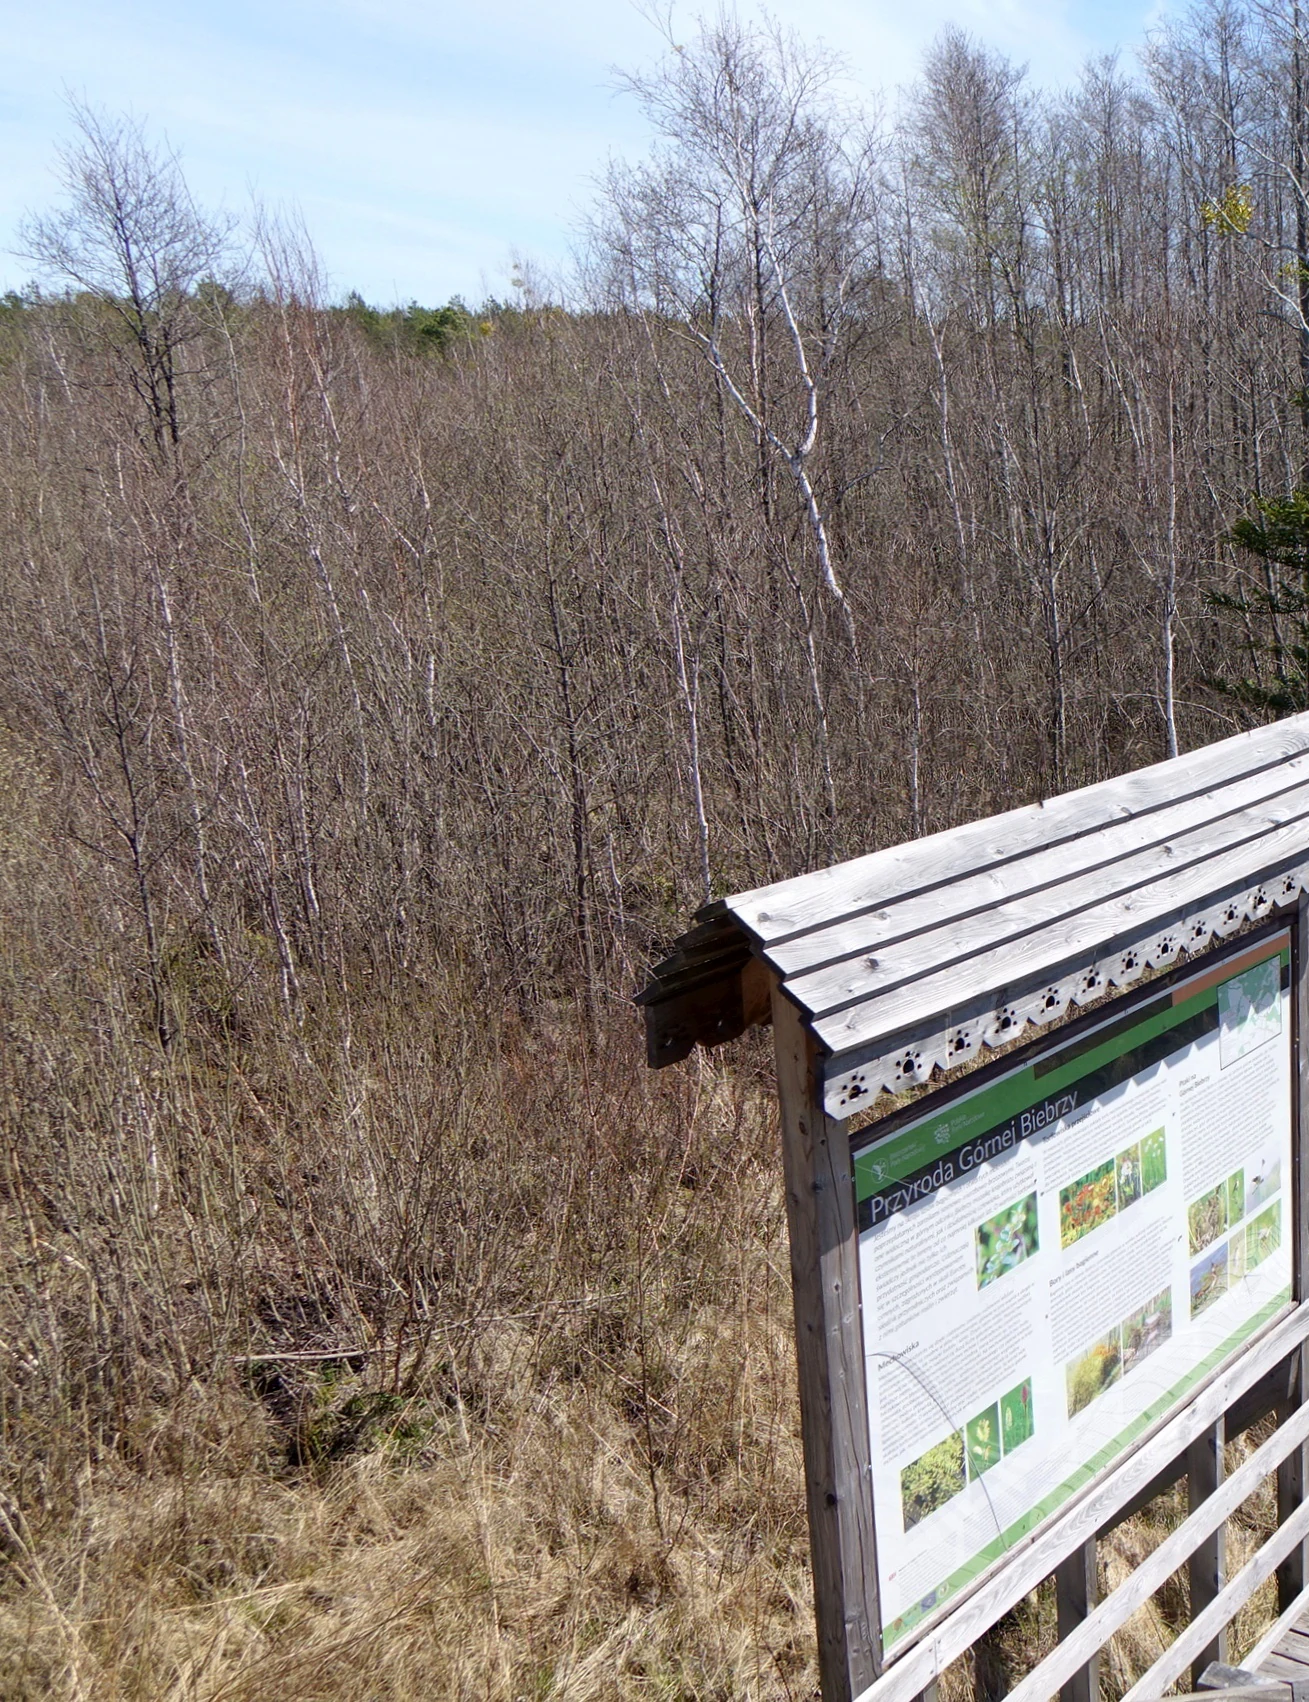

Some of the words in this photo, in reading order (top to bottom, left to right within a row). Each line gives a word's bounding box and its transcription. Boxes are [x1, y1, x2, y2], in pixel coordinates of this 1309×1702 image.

[871, 1161, 954, 1223] Przyroda
[959, 1121, 1016, 1170] Górnej
[1021, 1091, 1077, 1137] Biebrzy
